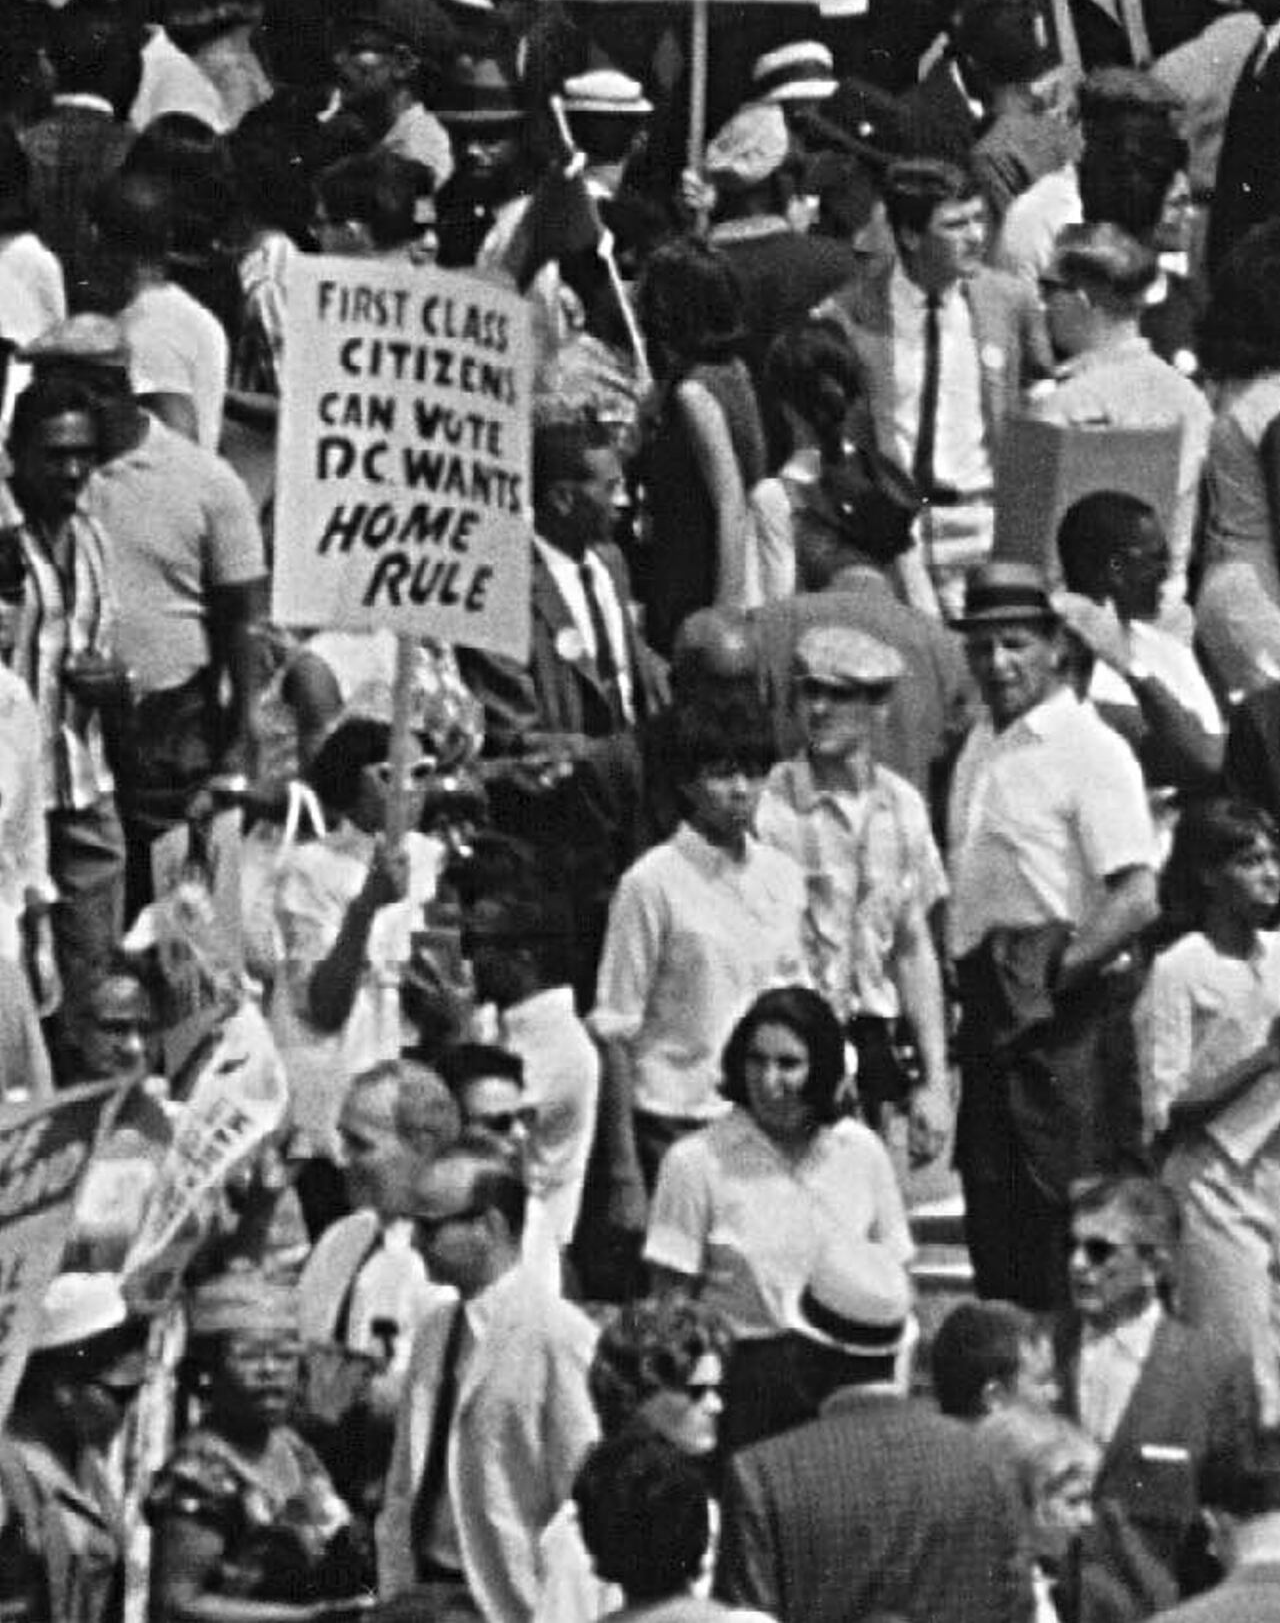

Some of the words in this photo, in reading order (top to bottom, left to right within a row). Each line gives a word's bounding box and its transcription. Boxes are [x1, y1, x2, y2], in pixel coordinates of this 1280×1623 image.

[318, 280, 410, 326] FIRST
[422, 295, 507, 353] CLASS
[319, 392, 395, 433] CAN
[404, 448, 521, 513] WANTS
[319, 504, 479, 554] HOME
[363, 552, 492, 610] RULE
